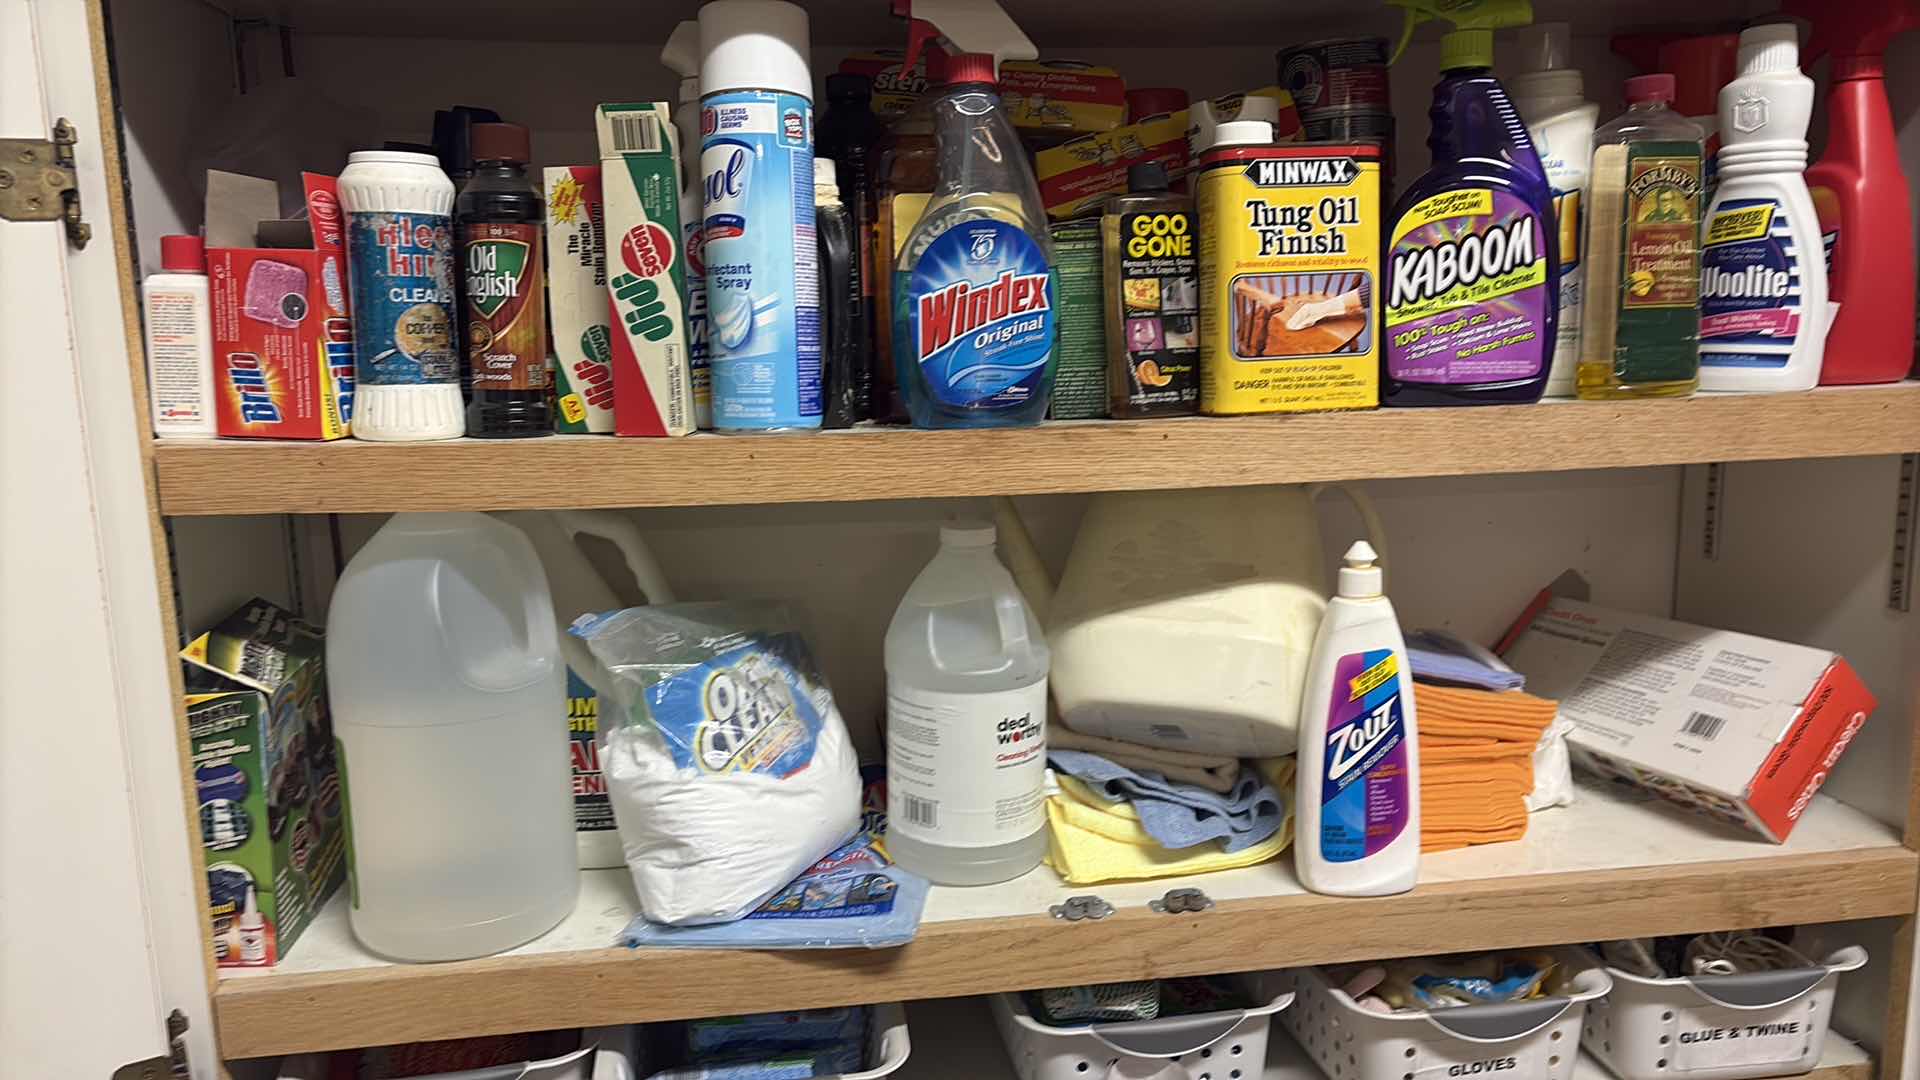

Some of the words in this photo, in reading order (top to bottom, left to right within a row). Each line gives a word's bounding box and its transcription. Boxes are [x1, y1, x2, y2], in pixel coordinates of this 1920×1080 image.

[1258, 160, 1348, 185] MINWAX
[1132, 213, 1188, 237] GOO
[1246, 200, 1314, 233] Tung
[1318, 197, 1360, 225] Oil
[1424, 205, 1449, 219] SOAP
[567, 233, 579, 255] The
[579, 222, 594, 267] Miracle
[630, 224, 665, 278] seven
[1127, 235, 1192, 258] GONE
[1258, 227, 1346, 257] Finish
[1631, 241, 1673, 257] Lemon
[1673, 239, 1693, 254] Oil
[469, 244, 497, 275] Old
[593, 256, 608, 287] Stain
[1390, 216, 1533, 308] KABOOM
[1631, 256, 1692, 272] Treatment
[716, 276, 752, 291] Spray
[1493, 271, 1537, 290] Cleaner
[1701, 264, 1789, 298] Woolite
[611, 272, 675, 343] did
[920, 271, 1049, 359] Windex
[973, 314, 1044, 350] Original
[1430, 317, 1468, 337] Tough
[226, 351, 283, 425] Brillo
[996, 711, 1031, 732] deal
[996, 720, 1043, 745] worthy
[1328, 695, 1398, 782] Zout
[1338, 767, 1364, 790] STAIN
[1363, 735, 1400, 775] REMOVER
[1679, 1027, 1722, 1044] GLUE
[1729, 1026, 1739, 1039] &
[1746, 1021, 1801, 1038] TWINE
[1449, 1057, 1518, 1078] GLOVES
